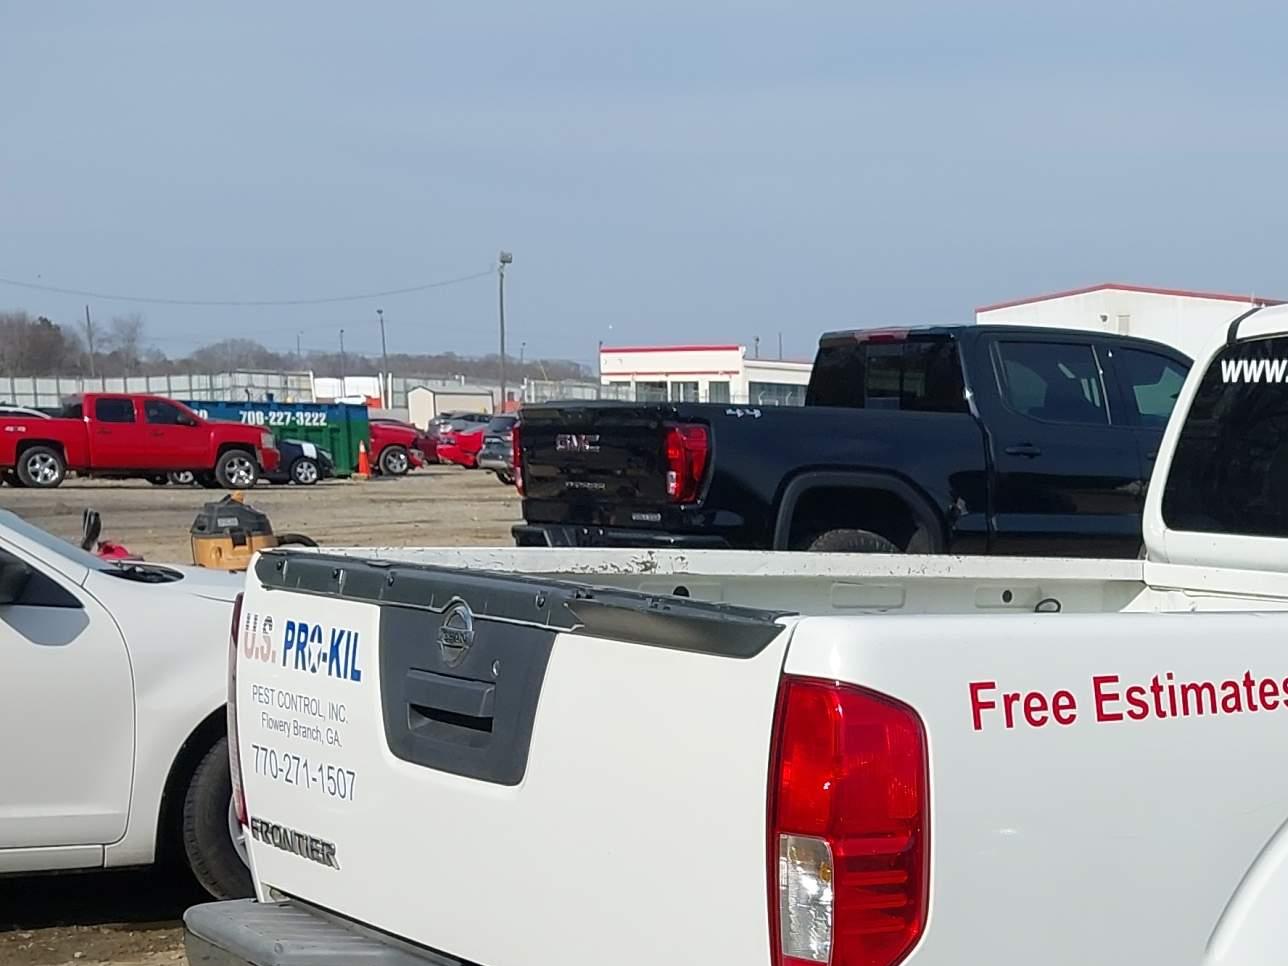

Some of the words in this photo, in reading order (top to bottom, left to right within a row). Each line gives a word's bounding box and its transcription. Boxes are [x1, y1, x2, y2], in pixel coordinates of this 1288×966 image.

[244, 612, 276, 663] U.S.
[282, 619, 362, 682] PRO-KIL
[252, 684, 275, 706] PEST
[277, 690, 326, 721] CONTROL,
[328, 701, 349, 724] INC.
[261, 711, 291, 738] Flowery
[292, 719, 324, 745] Branch,
[969, 681, 1077, 730] Free
[252, 744, 356, 801] 770-271-1507
[251, 816, 340, 870] FRONTIER
